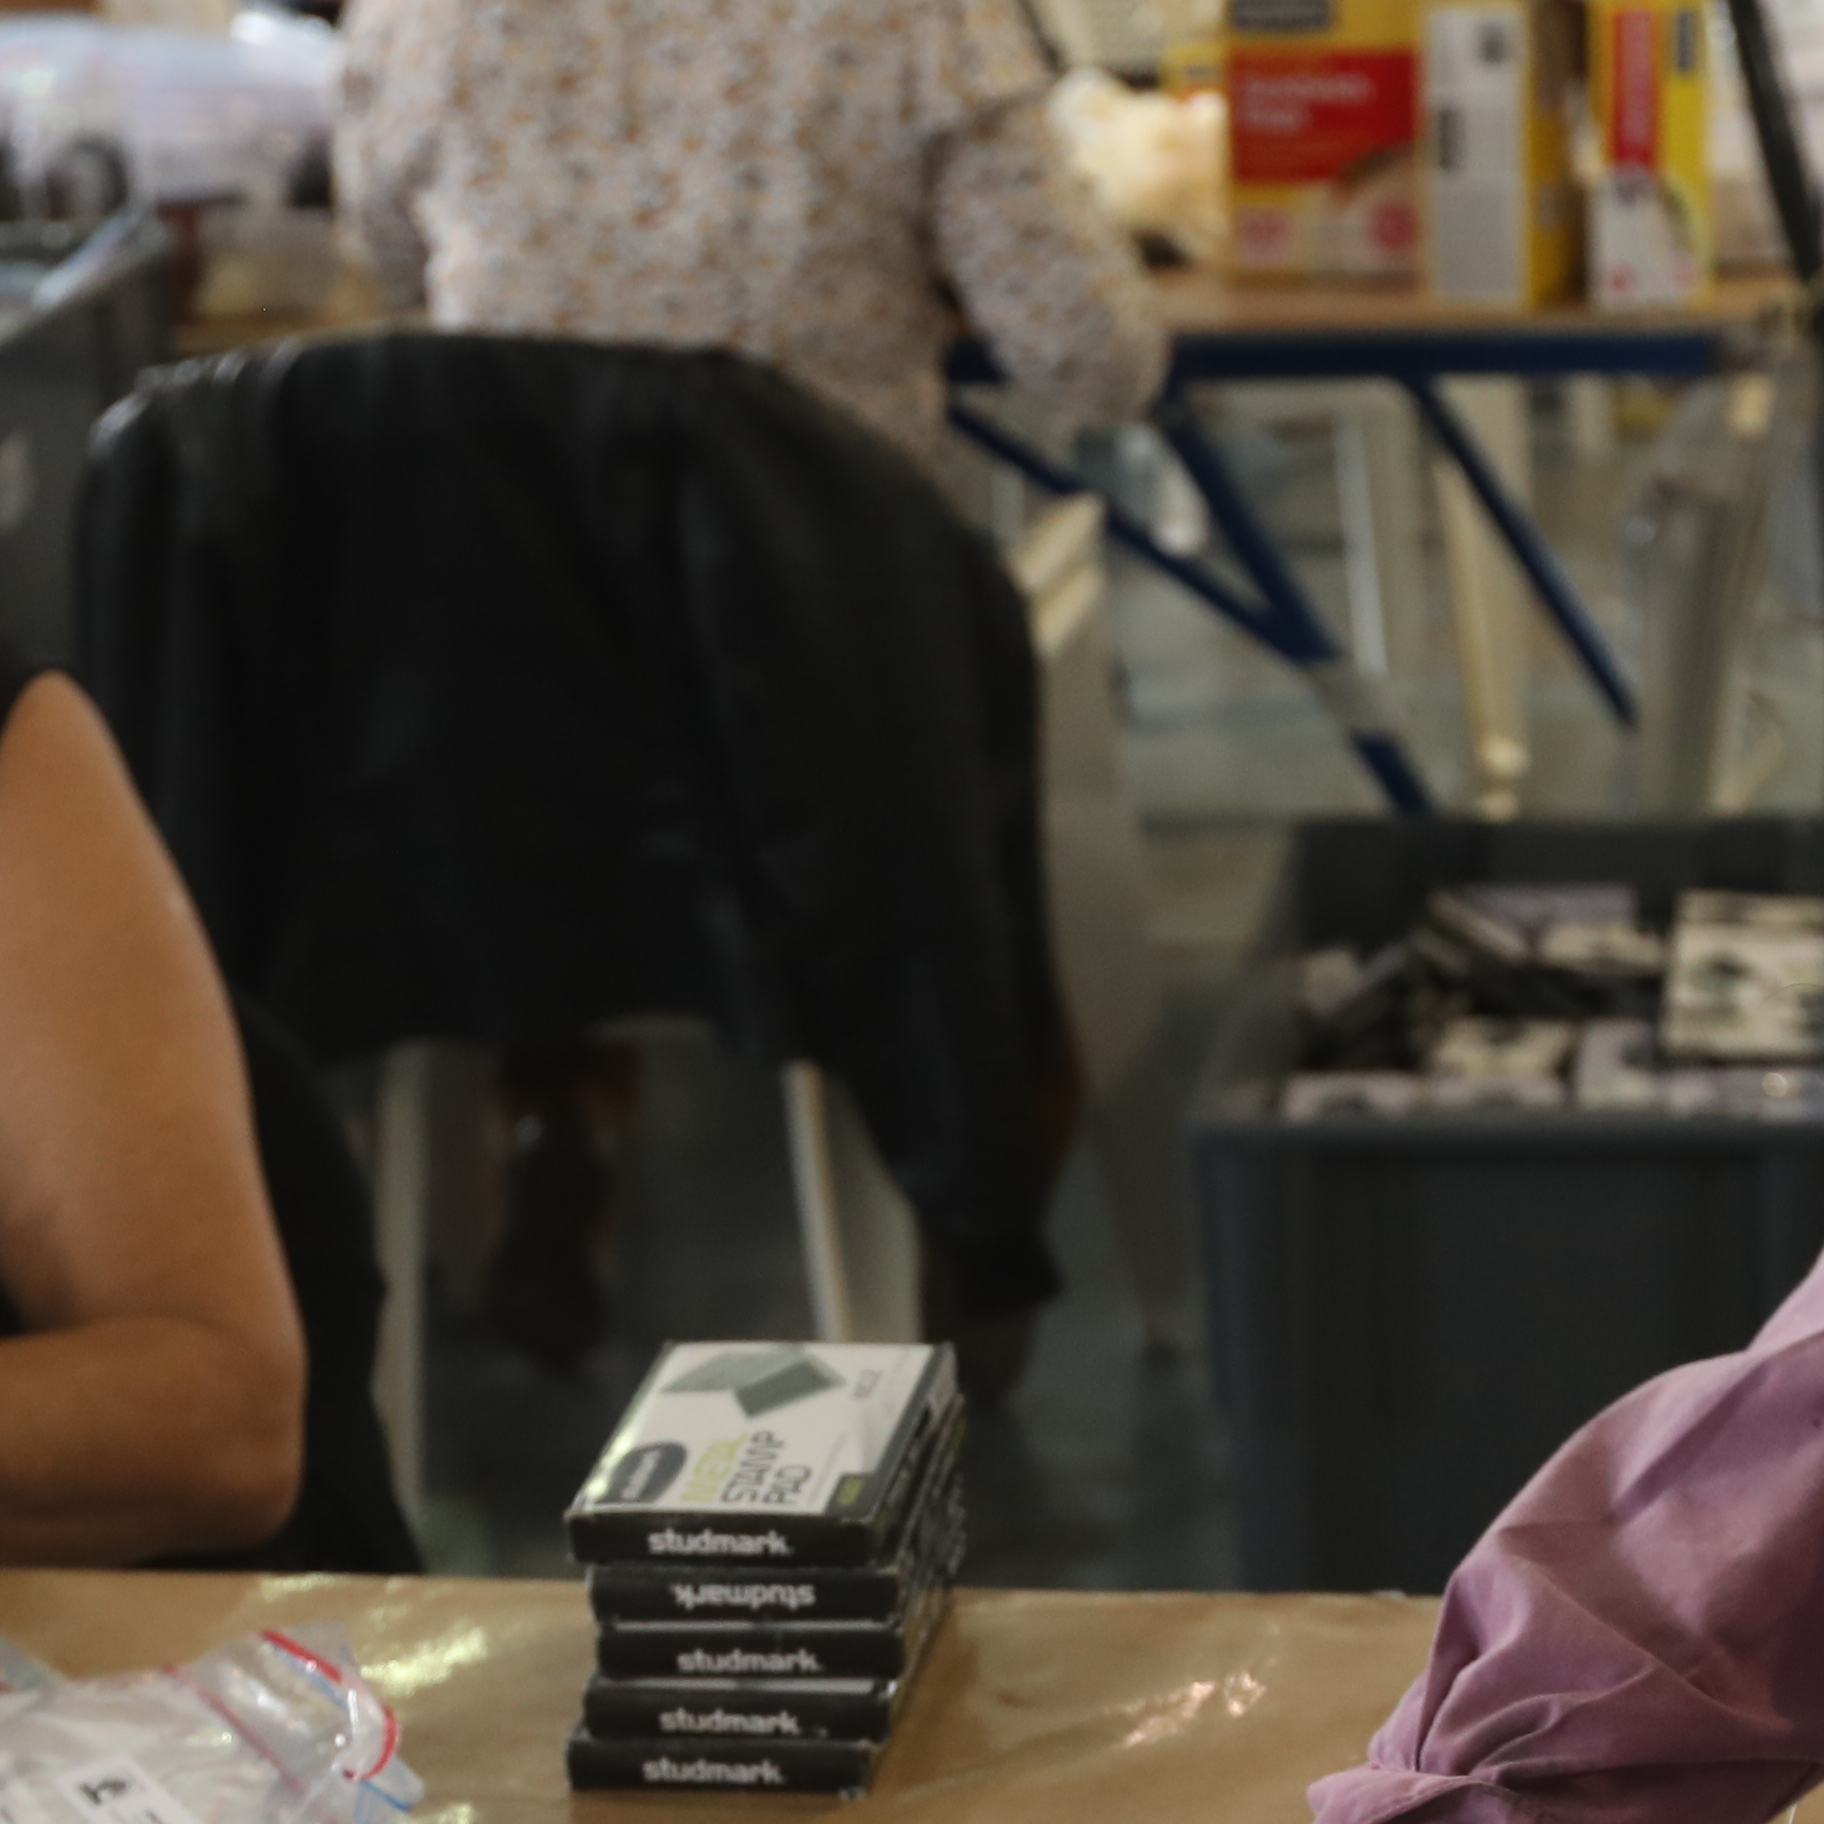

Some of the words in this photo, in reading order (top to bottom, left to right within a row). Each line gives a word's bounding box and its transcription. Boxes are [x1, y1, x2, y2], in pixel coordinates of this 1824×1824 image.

[762, 1464, 812, 1504] PAD
[647, 1528, 793, 1555] studmark
[669, 1584, 816, 1611] studmark
[677, 1648, 823, 1672] studmark
[659, 1707, 800, 1734] studmark
[642, 1757, 786, 1784] studmark
